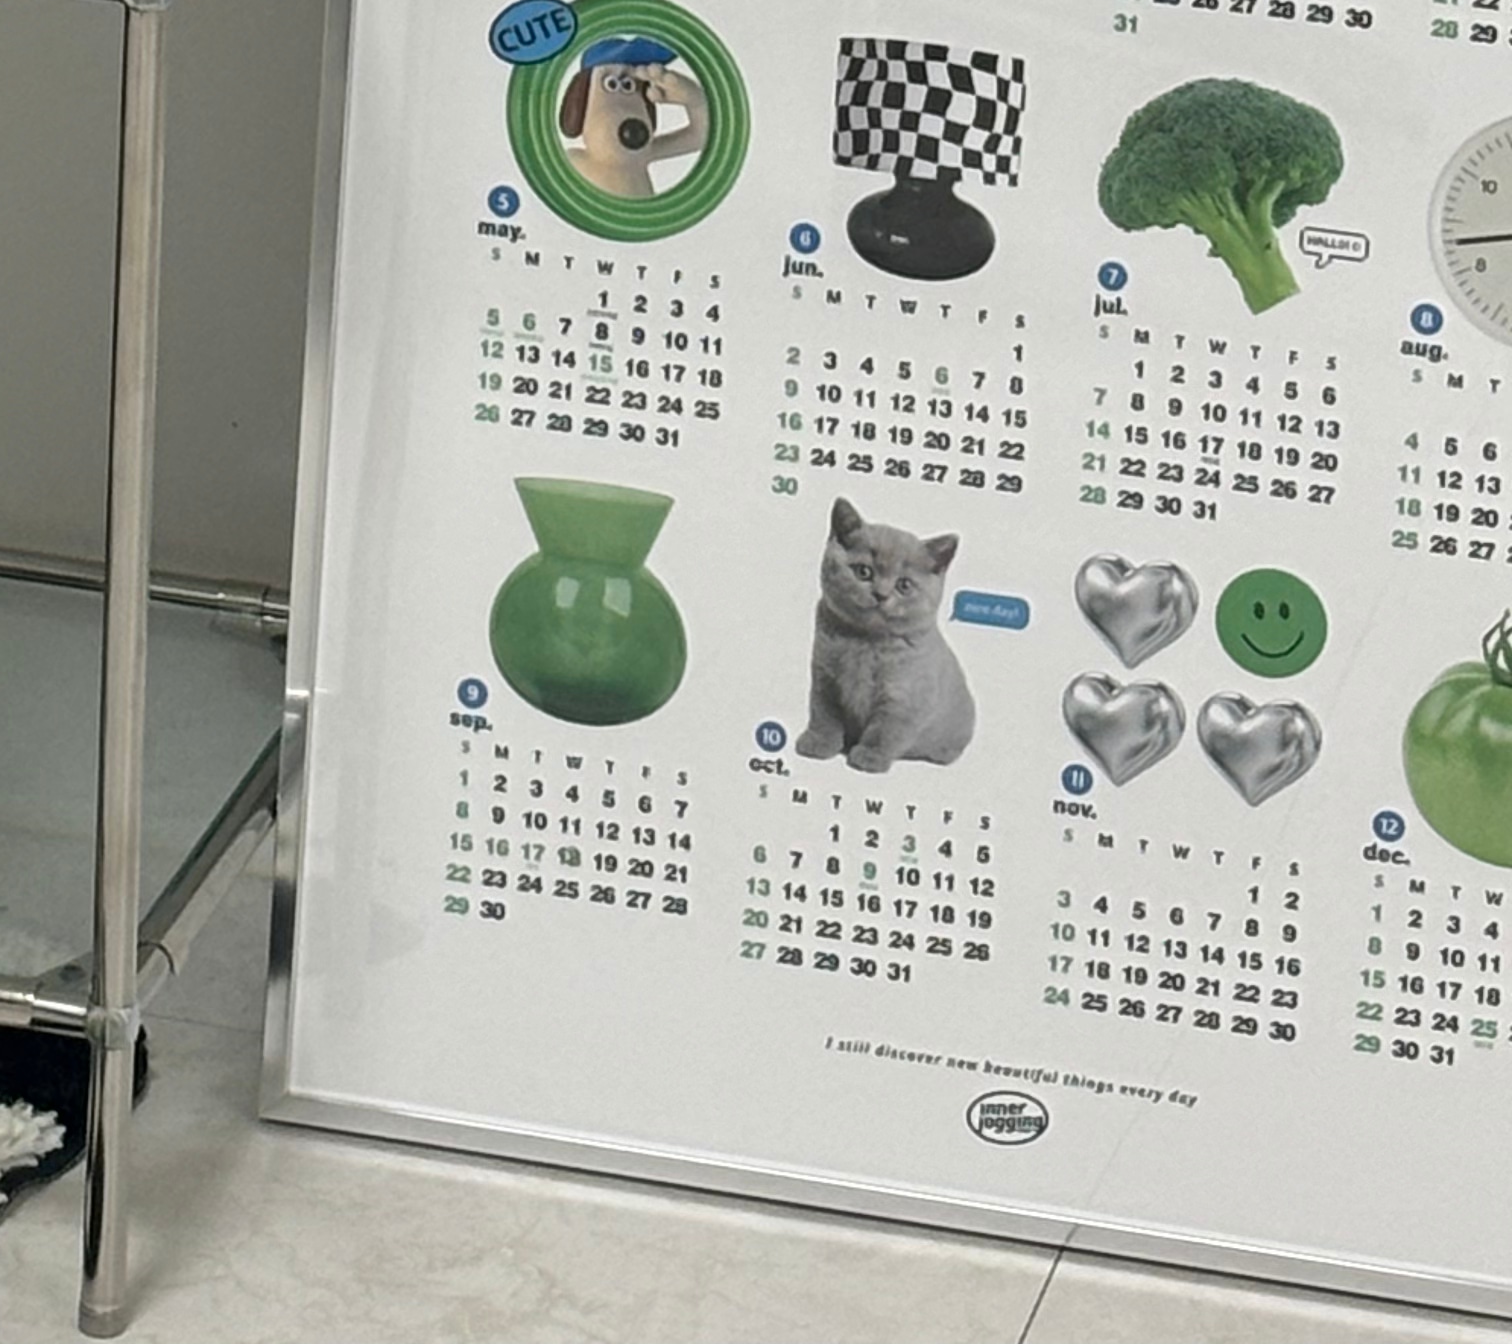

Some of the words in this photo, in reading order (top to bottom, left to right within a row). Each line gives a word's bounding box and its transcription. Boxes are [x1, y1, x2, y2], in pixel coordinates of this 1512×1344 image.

[497, 8, 572, 54] CUTE
[477, 221, 526, 242] may.
[782, 255, 824, 278] jun.
[1094, 293, 1128, 317] jul.
[480, 340, 504, 359] 12
[515, 345, 540, 364] 13
[552, 350, 576, 368] 14
[589, 354, 613, 373] 15
[626, 359, 649, 378] 16
[661, 364, 686, 383] 17
[697, 368, 722, 388] 18
[1400, 339, 1448, 363] aug.
[1093, 387, 1107, 405] 7
[1131, 393, 1145, 411] 8
[1168, 398, 1182, 416] 9
[1200, 402, 1227, 423] 10
[1239, 408, 1262, 428] 11
[1277, 413, 1302, 434] 12
[1314, 419, 1340, 439] 13
[1437, 470, 1462, 491] 12
[1475, 474, 1501, 496] 13
[449, 712, 492, 733] sep.
[749, 758, 790, 777] oct.
[1053, 799, 1097, 820] nov.
[492, 806, 505, 824] 9
[522, 811, 547, 830] 10
[559, 816, 581, 835] 11
[596, 821, 619, 841] 12
[632, 826, 655, 846] 13
[668, 832, 691, 851] 14
[1363, 844, 1410, 866] dec.
[783, 882, 806, 902] 14
[820, 888, 843, 907] 15
[857, 894, 881, 913] 16
[893, 899, 917, 918] 17
[1050, 922, 1075, 942] 10
[1087, 928, 1109, 947] 11
[1124, 933, 1150, 953] 12
[1163, 939, 1187, 959] 13
[1200, 944, 1224, 965] 14
[1237, 950, 1263, 971] 15
[1275, 956, 1300, 976] 16
[1397, 974, 1424, 995] 16
[1436, 980, 1462, 1000] 17
[874, 1044, 942, 1065] discover
[983, 1059, 1058, 1084] beautiful
[1063, 1073, 1114, 1094] things
[1168, 1089, 1198, 1108] day
